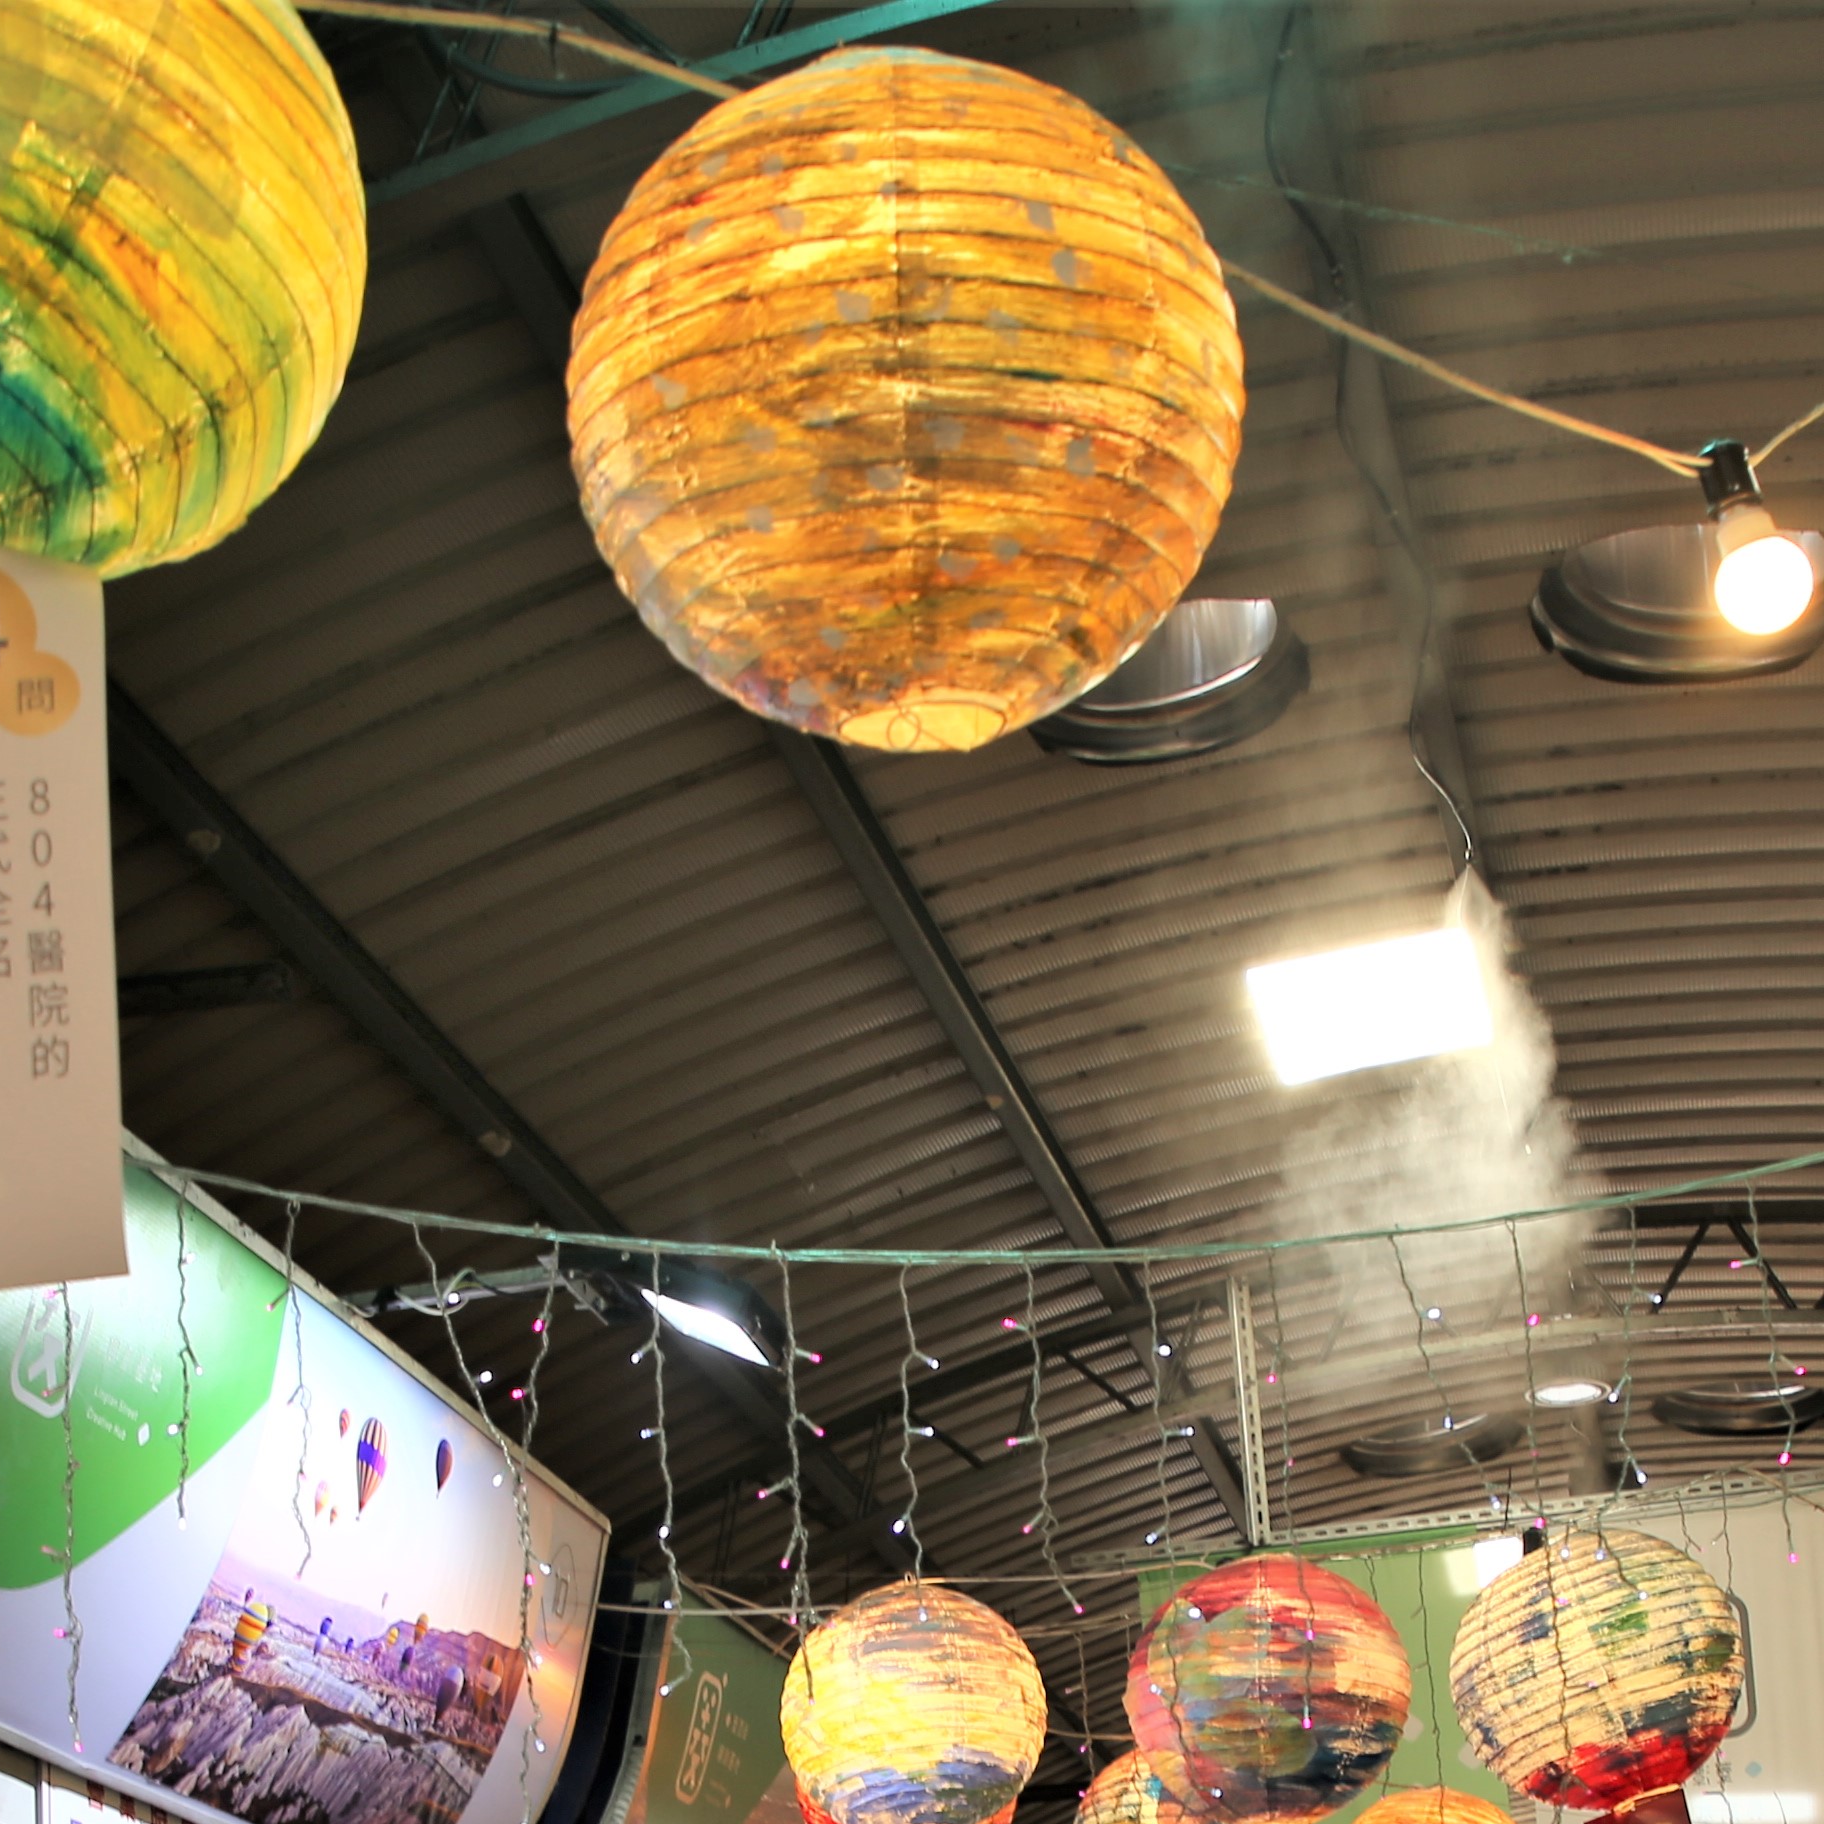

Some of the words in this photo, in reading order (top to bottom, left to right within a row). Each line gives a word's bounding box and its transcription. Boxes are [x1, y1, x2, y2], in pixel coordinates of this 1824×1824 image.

[17, 676, 55, 716] 問
[27, 778, 71, 1082] 804醫院的
